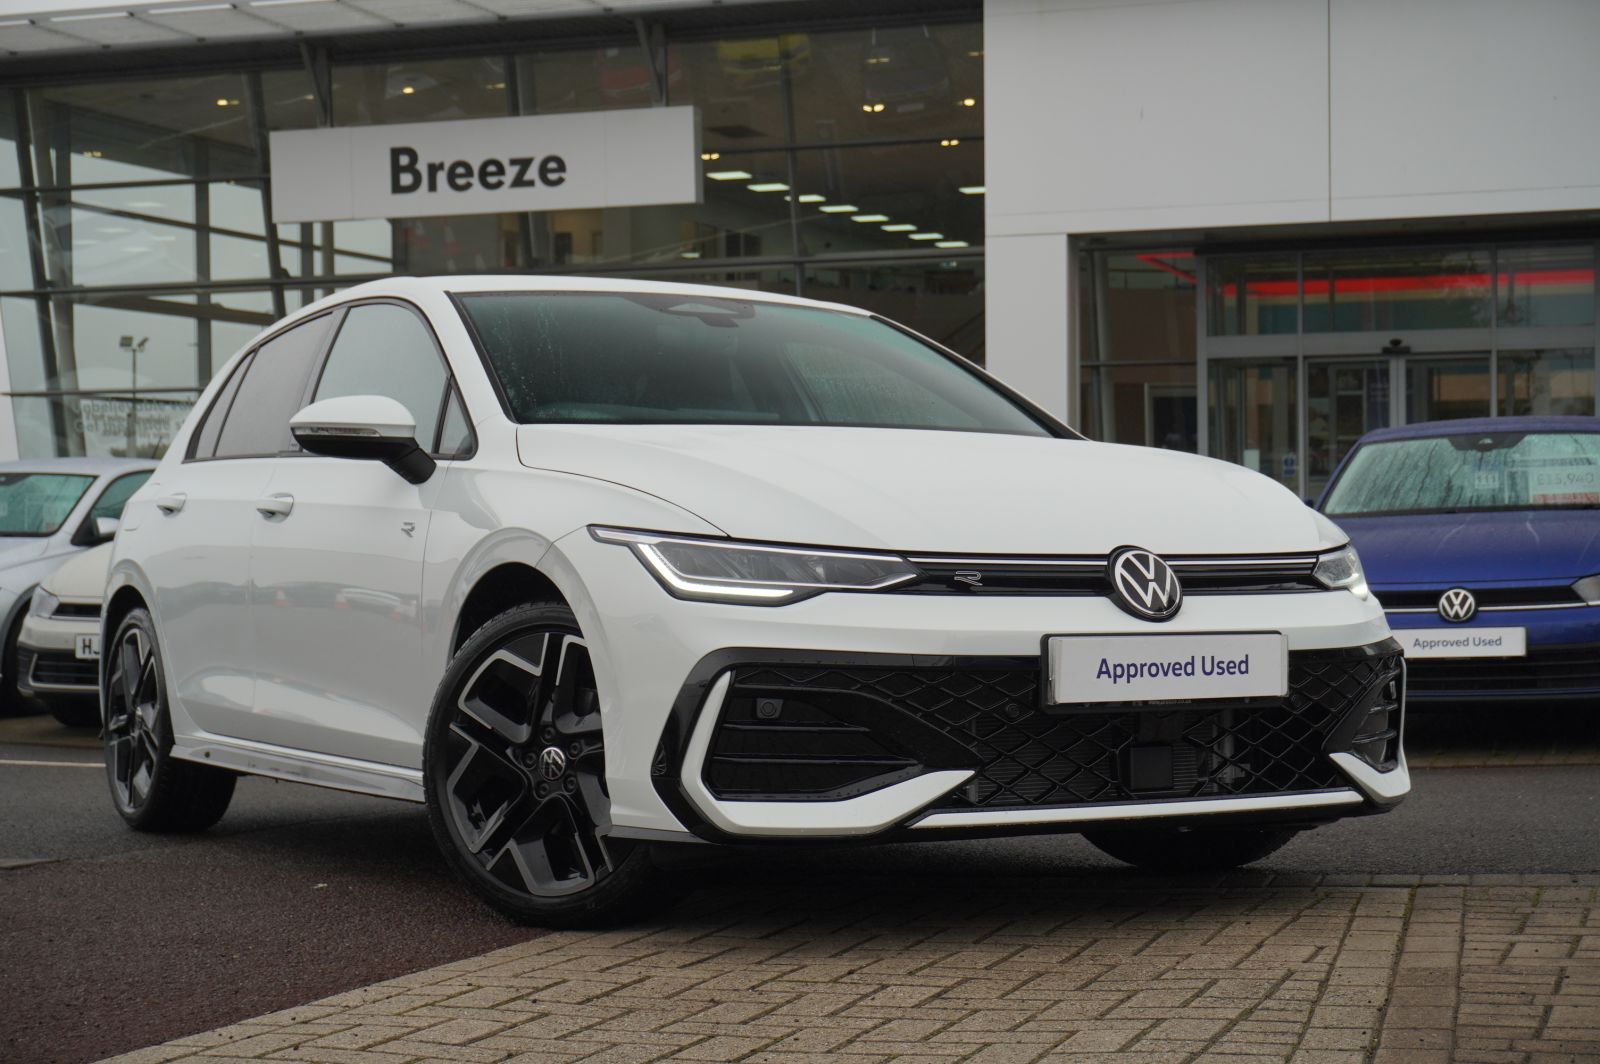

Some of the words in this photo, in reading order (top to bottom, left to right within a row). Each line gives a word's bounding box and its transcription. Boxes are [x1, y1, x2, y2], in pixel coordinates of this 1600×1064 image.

[390, 146, 567, 195] Breeze
[1413, 637, 1469, 649] Approved
[1473, 636, 1502, 647] Used
[1096, 656, 1195, 684] Approved
[1201, 654, 1249, 676] Used
